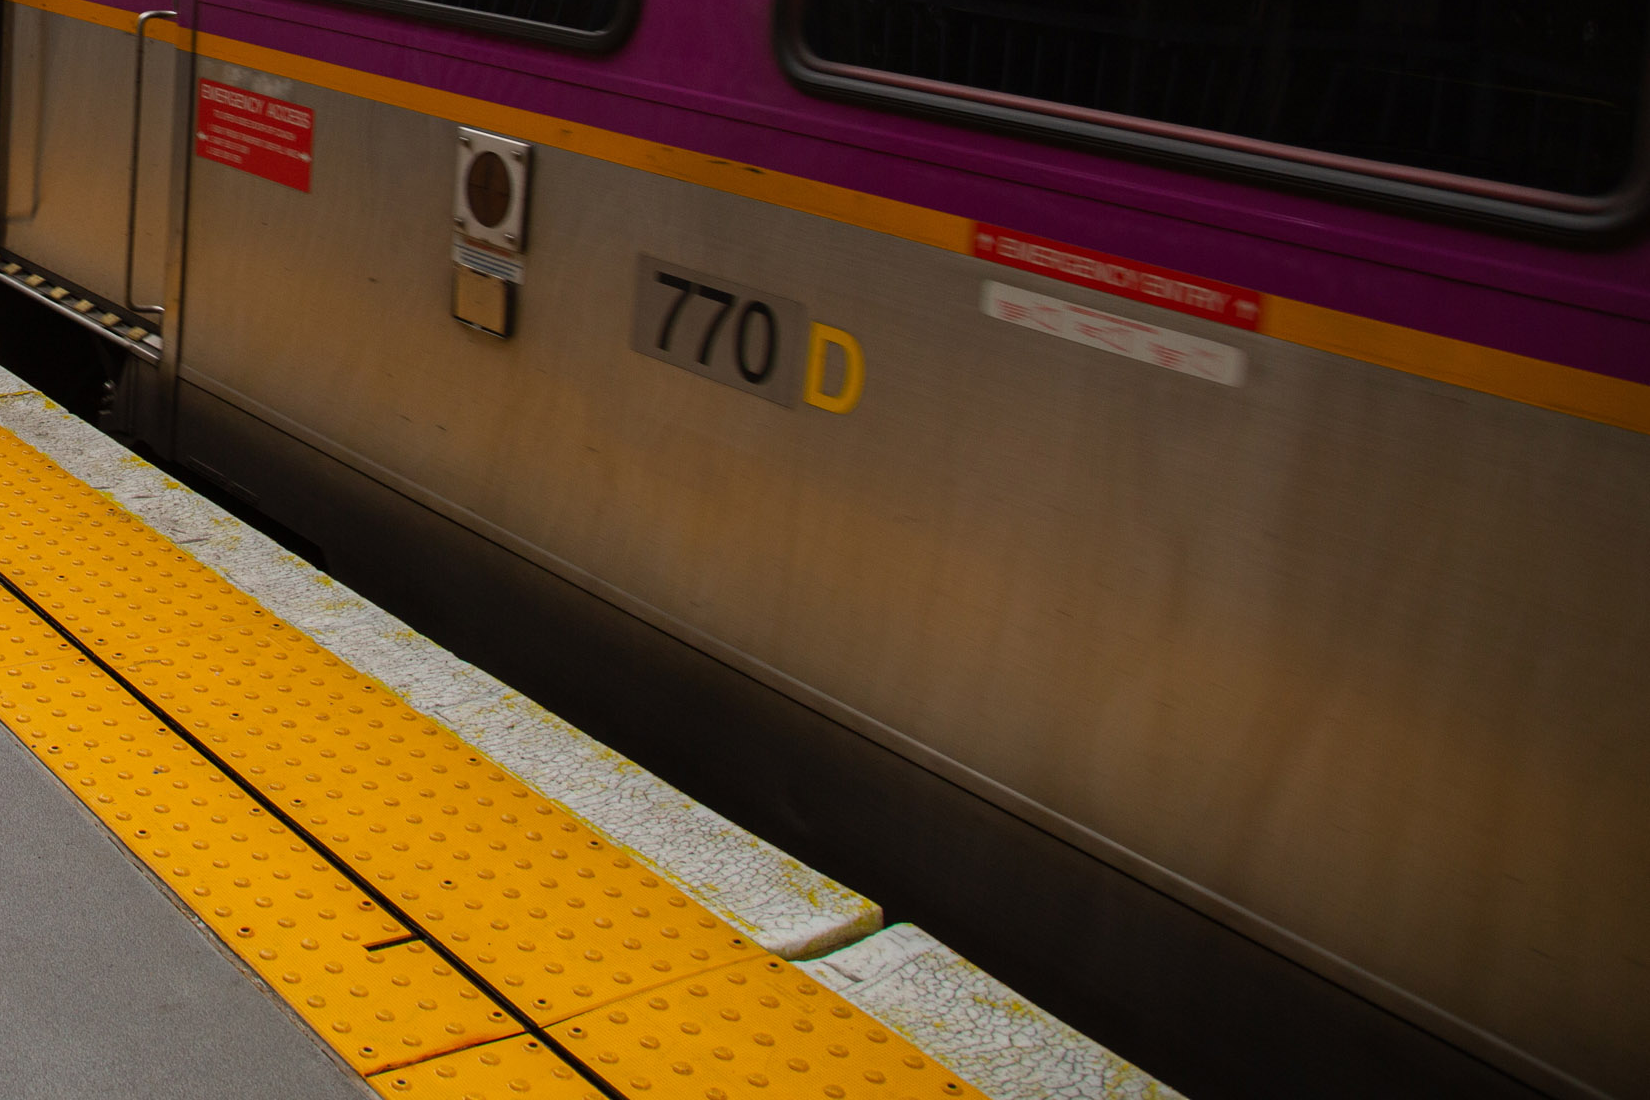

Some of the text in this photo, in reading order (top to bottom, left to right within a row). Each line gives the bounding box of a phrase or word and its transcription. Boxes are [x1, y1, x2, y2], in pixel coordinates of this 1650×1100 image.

[201, 83, 264, 115] EMERGENCY
[266, 102, 311, 129] ACCESS
[995, 235, 1139, 291] EMERGENCY
[655, 271, 779, 384] 770
[803, 321, 866, 415] D
